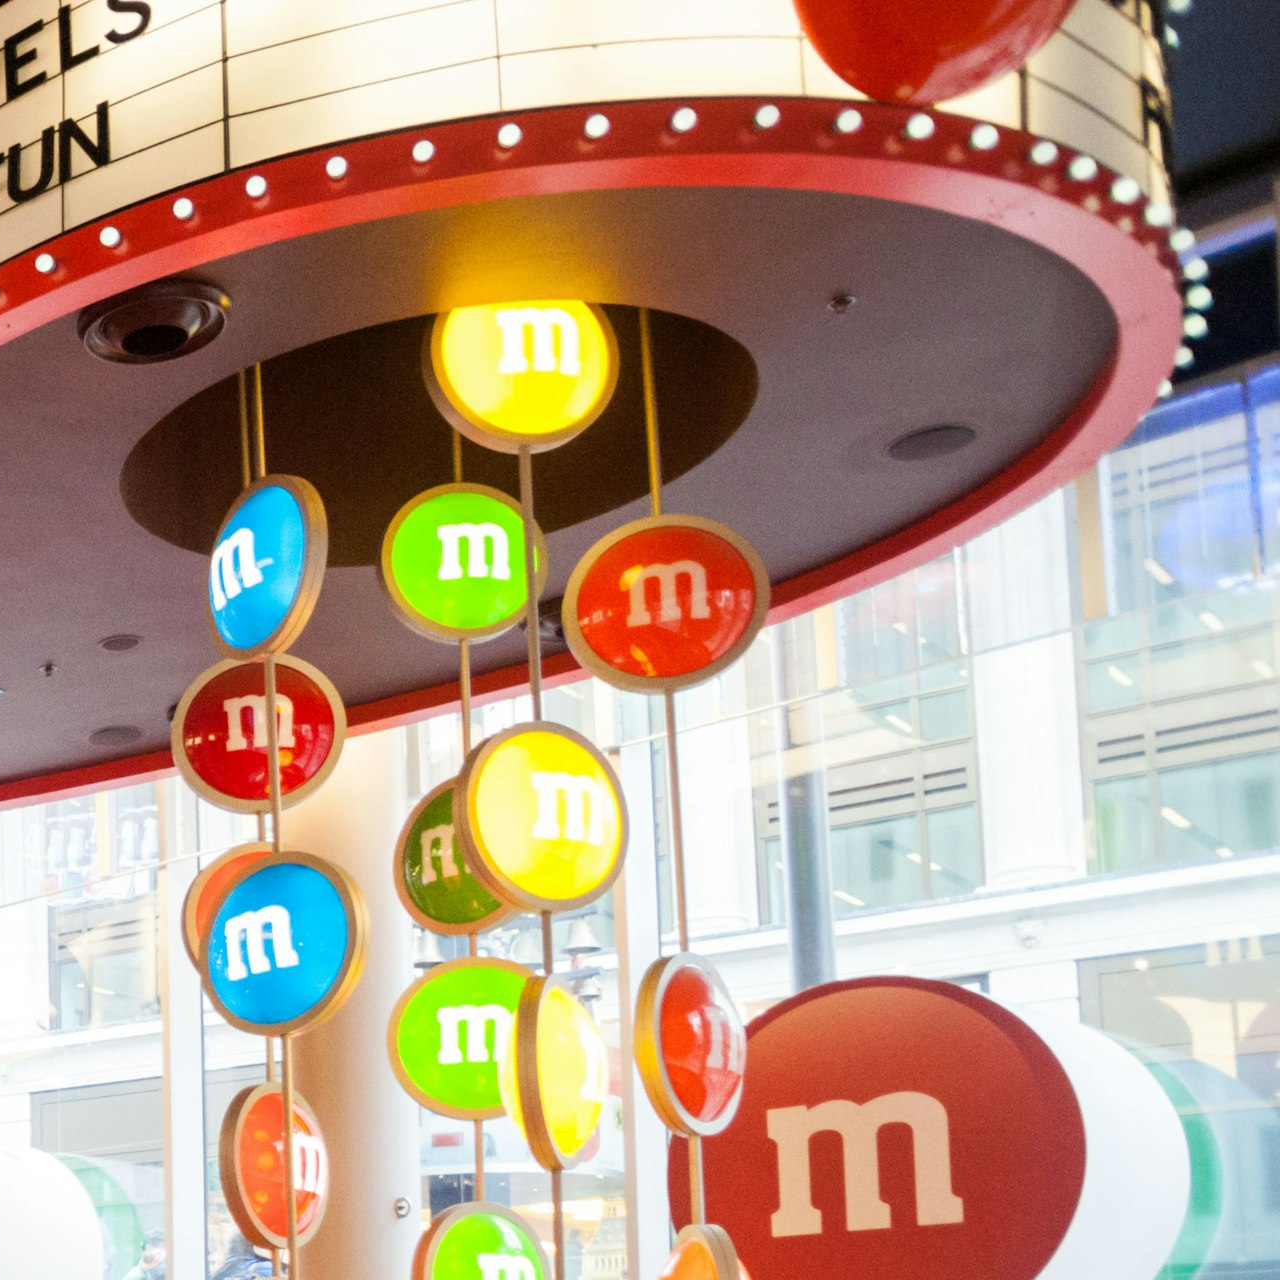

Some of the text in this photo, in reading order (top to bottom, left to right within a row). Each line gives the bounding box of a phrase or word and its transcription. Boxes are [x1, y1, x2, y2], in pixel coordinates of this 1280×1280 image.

[497, 308, 581, 375] m
[210, 527, 264, 611] m
[437, 521, 511, 580] m
[624, 558, 711, 627] m
[223, 692, 295, 752] m
[531, 772, 605, 845] m
[224, 904, 300, 982] m
[437, 1004, 516, 1064] m
[766, 1089, 965, 1238] m
